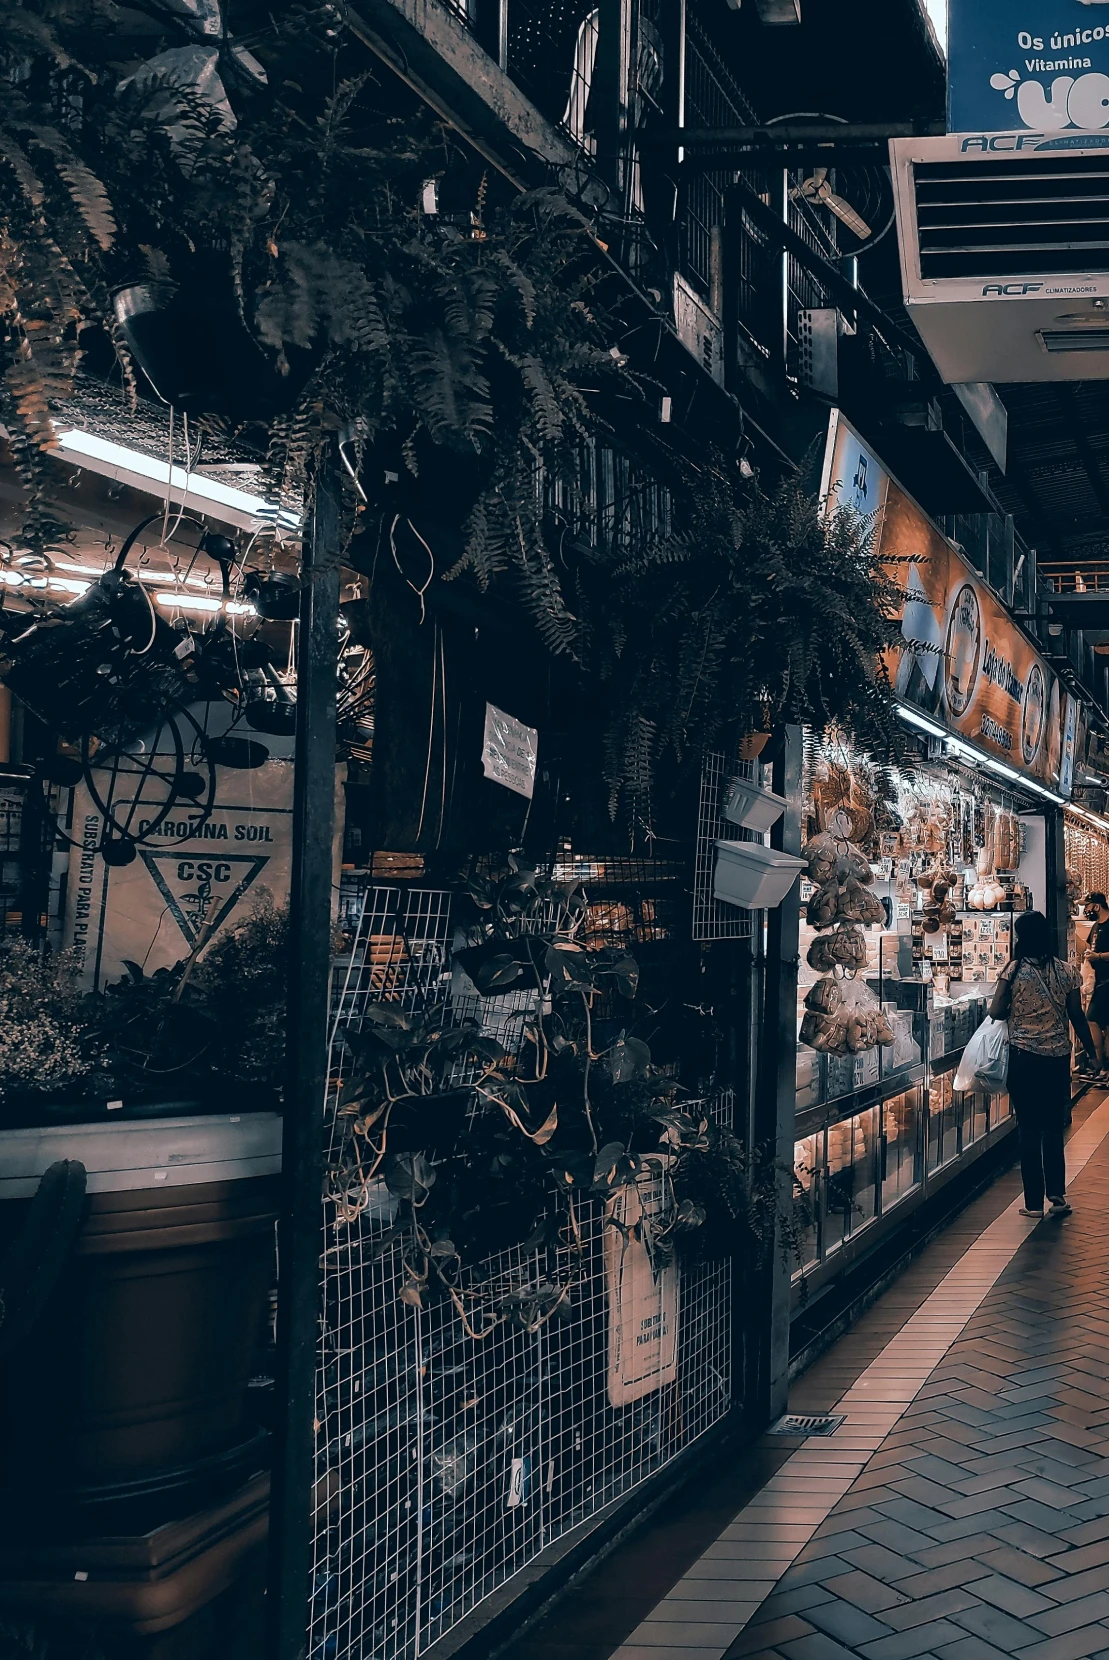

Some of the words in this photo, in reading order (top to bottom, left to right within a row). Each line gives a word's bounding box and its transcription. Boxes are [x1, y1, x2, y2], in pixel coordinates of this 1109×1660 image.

[1017, 31, 1044, 50] Os
[1025, 55, 1092, 72] Vitamina
[961, 134, 1044, 152] ACF
[982, 283, 1044, 296] ACF
[1045, 286, 1098, 294] CLIMATIZADORES
[233, 825, 274, 842] SOIL
[177, 862, 231, 883] CSC
[75, 886, 94, 921] PARA
